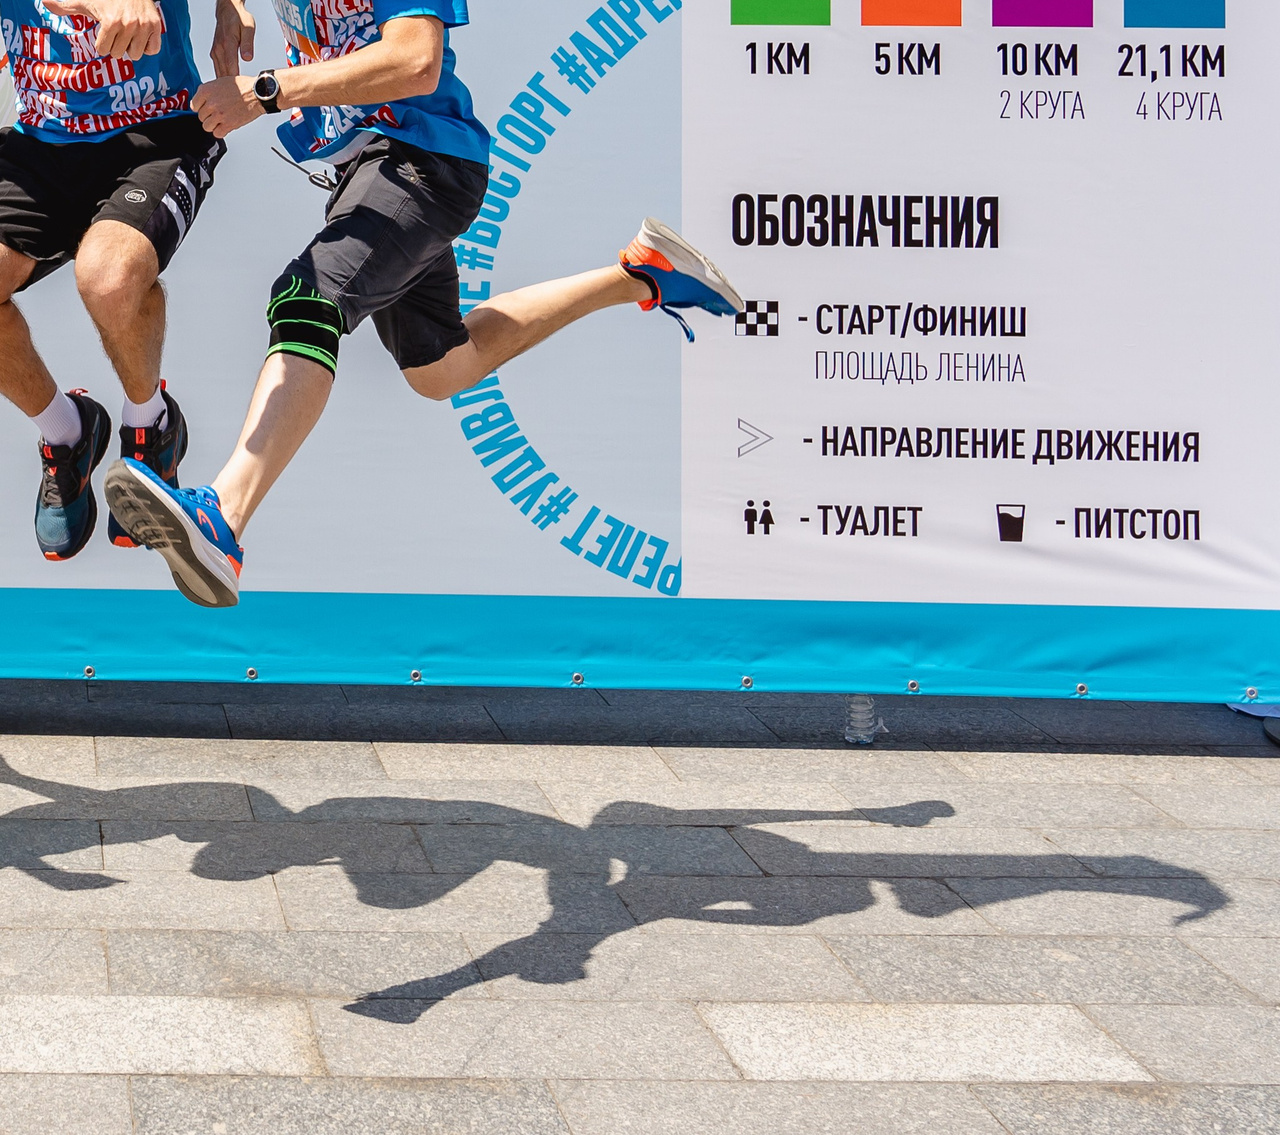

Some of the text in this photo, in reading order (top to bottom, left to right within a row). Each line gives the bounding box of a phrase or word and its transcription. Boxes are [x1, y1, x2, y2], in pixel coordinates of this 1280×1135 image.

[745, 42, 811, 75] 1 КМ
[873, 42, 942, 76] 5 КМ
[996, 43, 1079, 77] 10 КМ
[1117, 44, 1226, 83] 21,1 КМ
[999, 90, 1086, 120] 2 КРУГА
[1135, 91, 1223, 122] 4 КРУГА
[731, 193, 1000, 249] ОБОЗНАЧЕНИЯ
[815, 302, 1028, 338] СТАРТ/ФИНИШ
[814, 350, 1026, 386] ПЛОЩАДЬ ЛЕНИНА
[820, 425, 1026, 460] НАПРАВЛЕНИЕ
[1032, 429, 1201, 466] ДВИЖЕНИЯ
[817, 505, 924, 537] ТУАЛЕТ
[1073, 507, 1201, 541] ПИТСТОП
